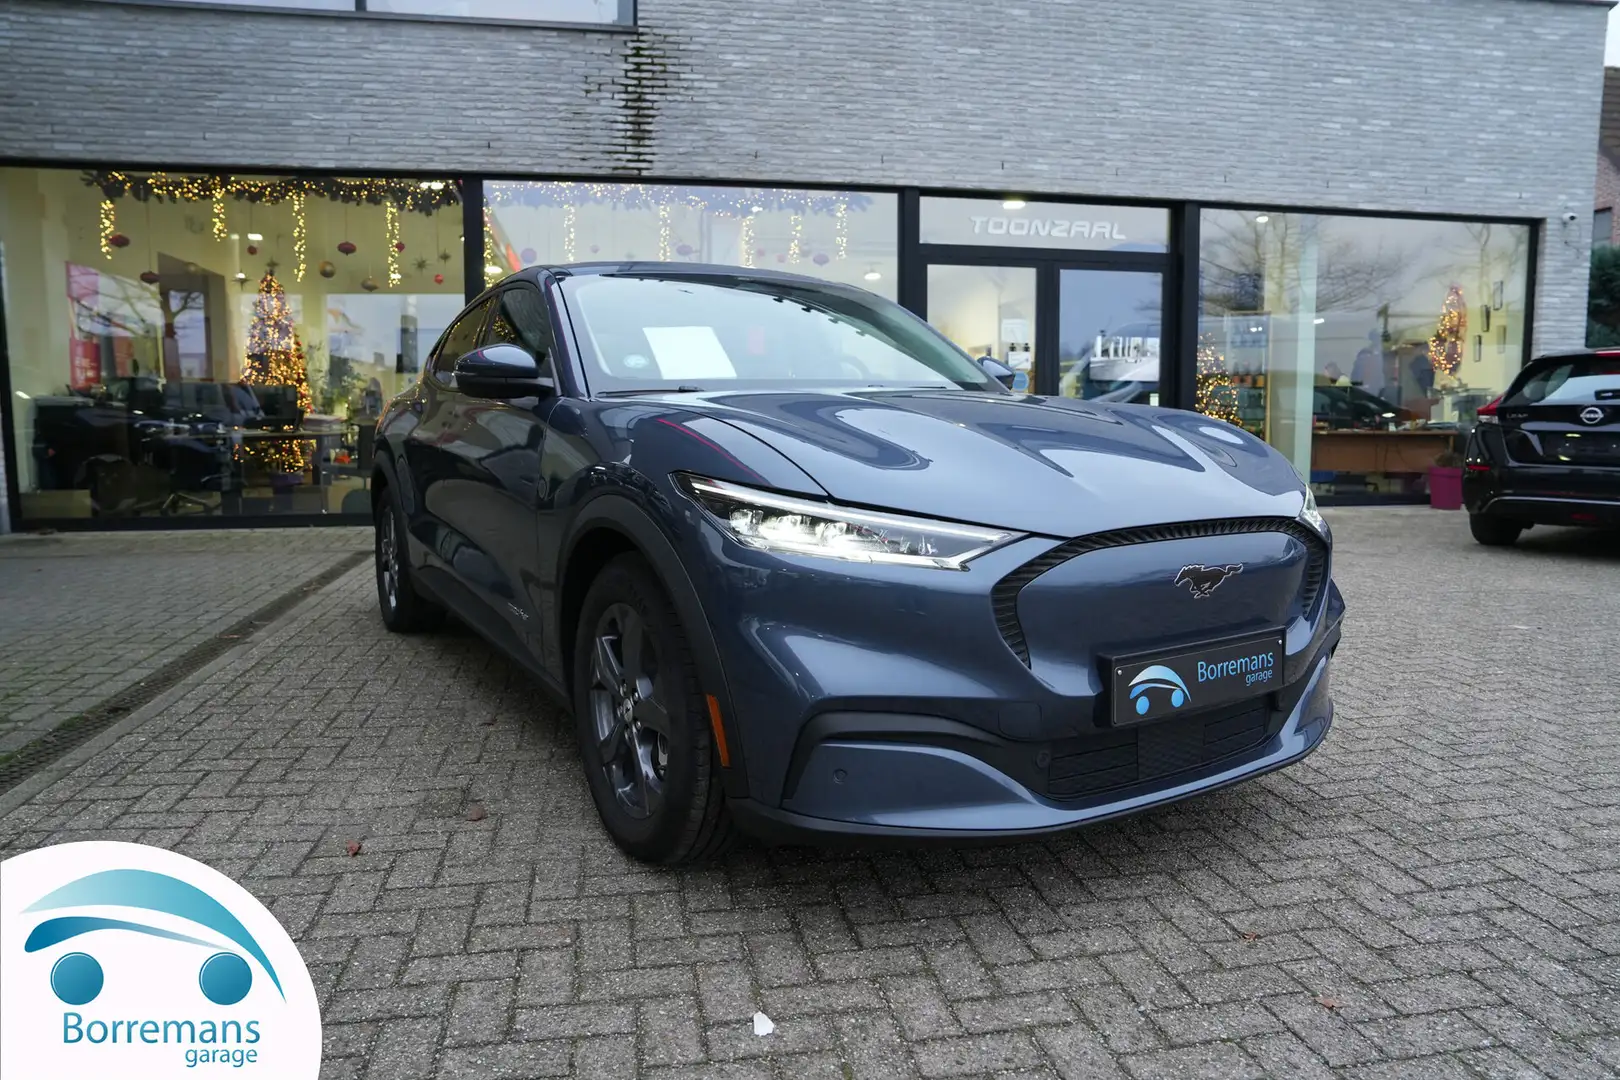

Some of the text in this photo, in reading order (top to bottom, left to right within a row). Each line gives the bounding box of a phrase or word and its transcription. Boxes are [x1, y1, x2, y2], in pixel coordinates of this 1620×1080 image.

[970, 215, 1127, 240] TOONZAAL
[1197, 652, 1274, 683] Borremans
[1245, 668, 1273, 687] garage
